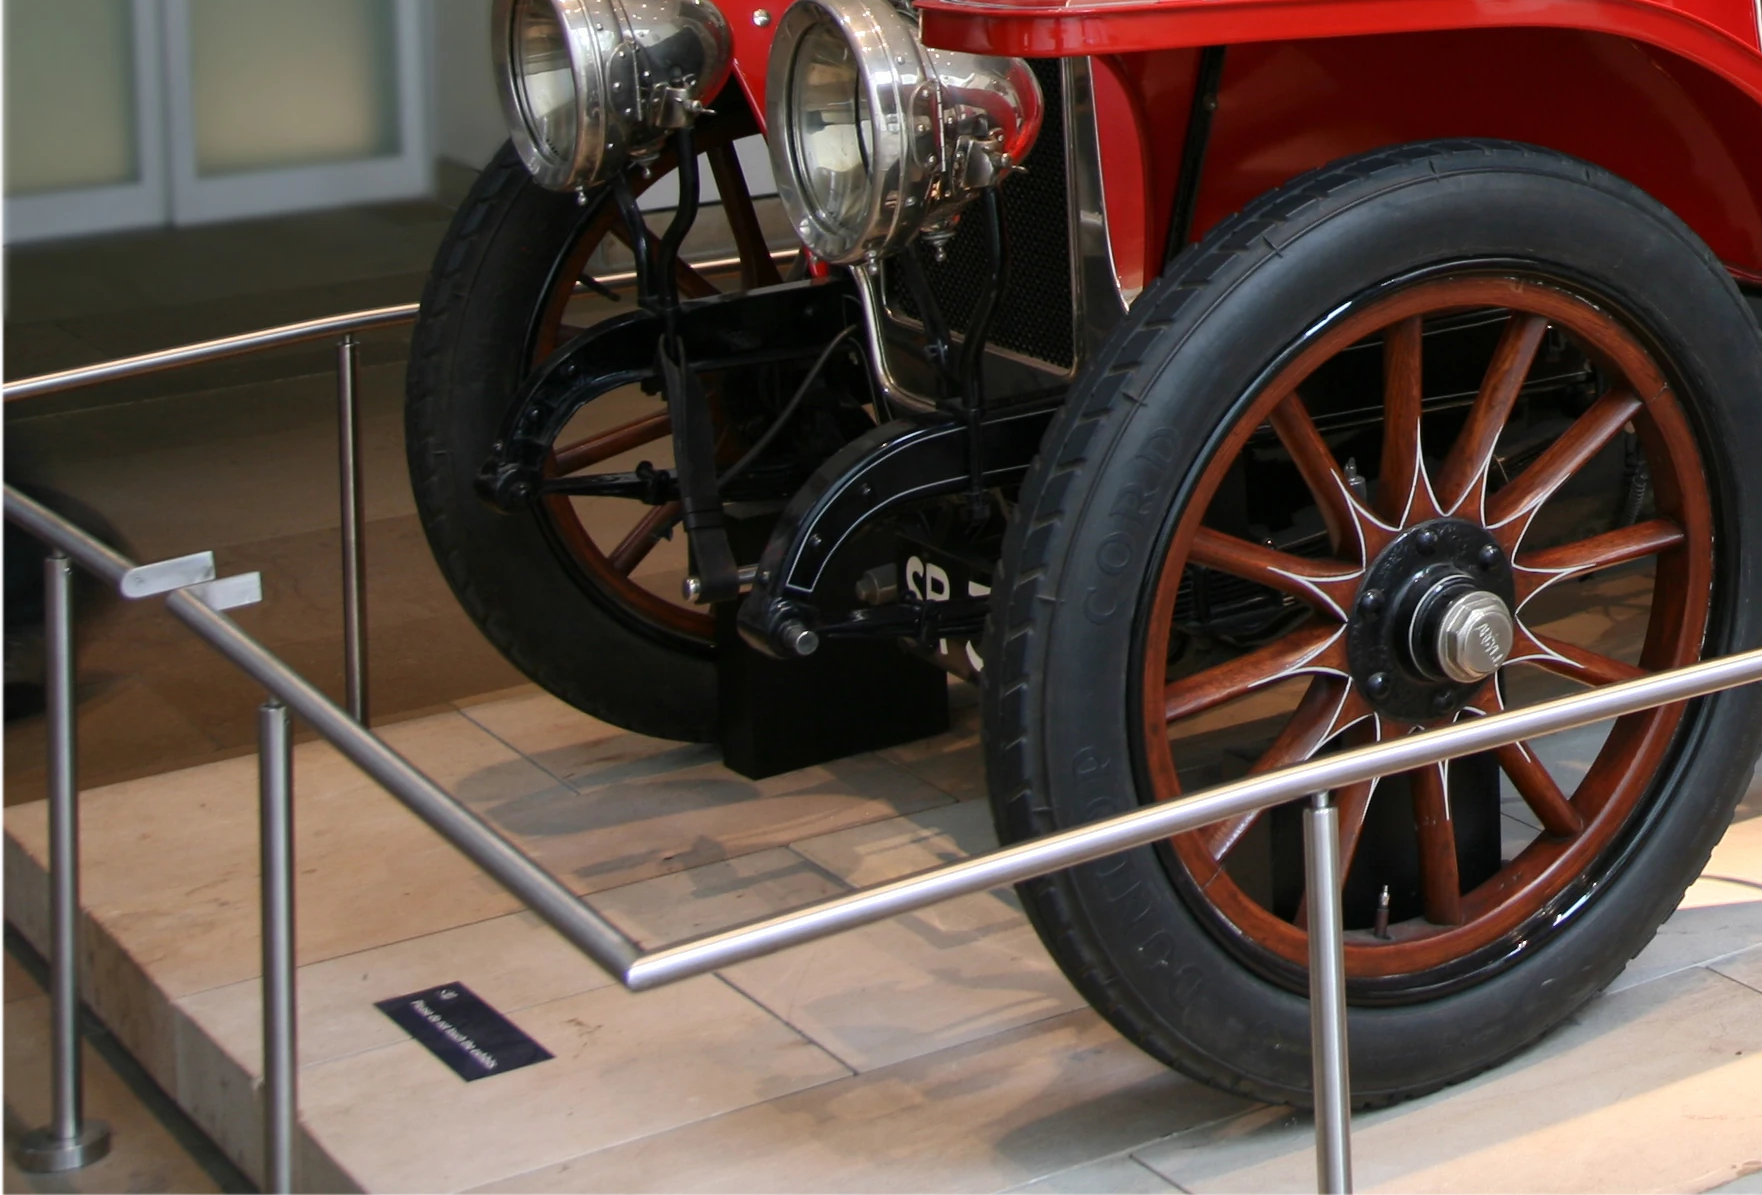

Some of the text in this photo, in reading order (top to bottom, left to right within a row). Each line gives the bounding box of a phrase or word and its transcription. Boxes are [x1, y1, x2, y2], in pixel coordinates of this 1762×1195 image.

[1083, 426, 1181, 626] CORD
[1473, 623, 1504, 668] ARGYLL
[410, 999, 435, 1017] Please
[427, 1014, 442, 1023] do
[435, 1020, 453, 1031] not
[444, 1027, 468, 1043] touch
[459, 1039, 476, 1051] the
